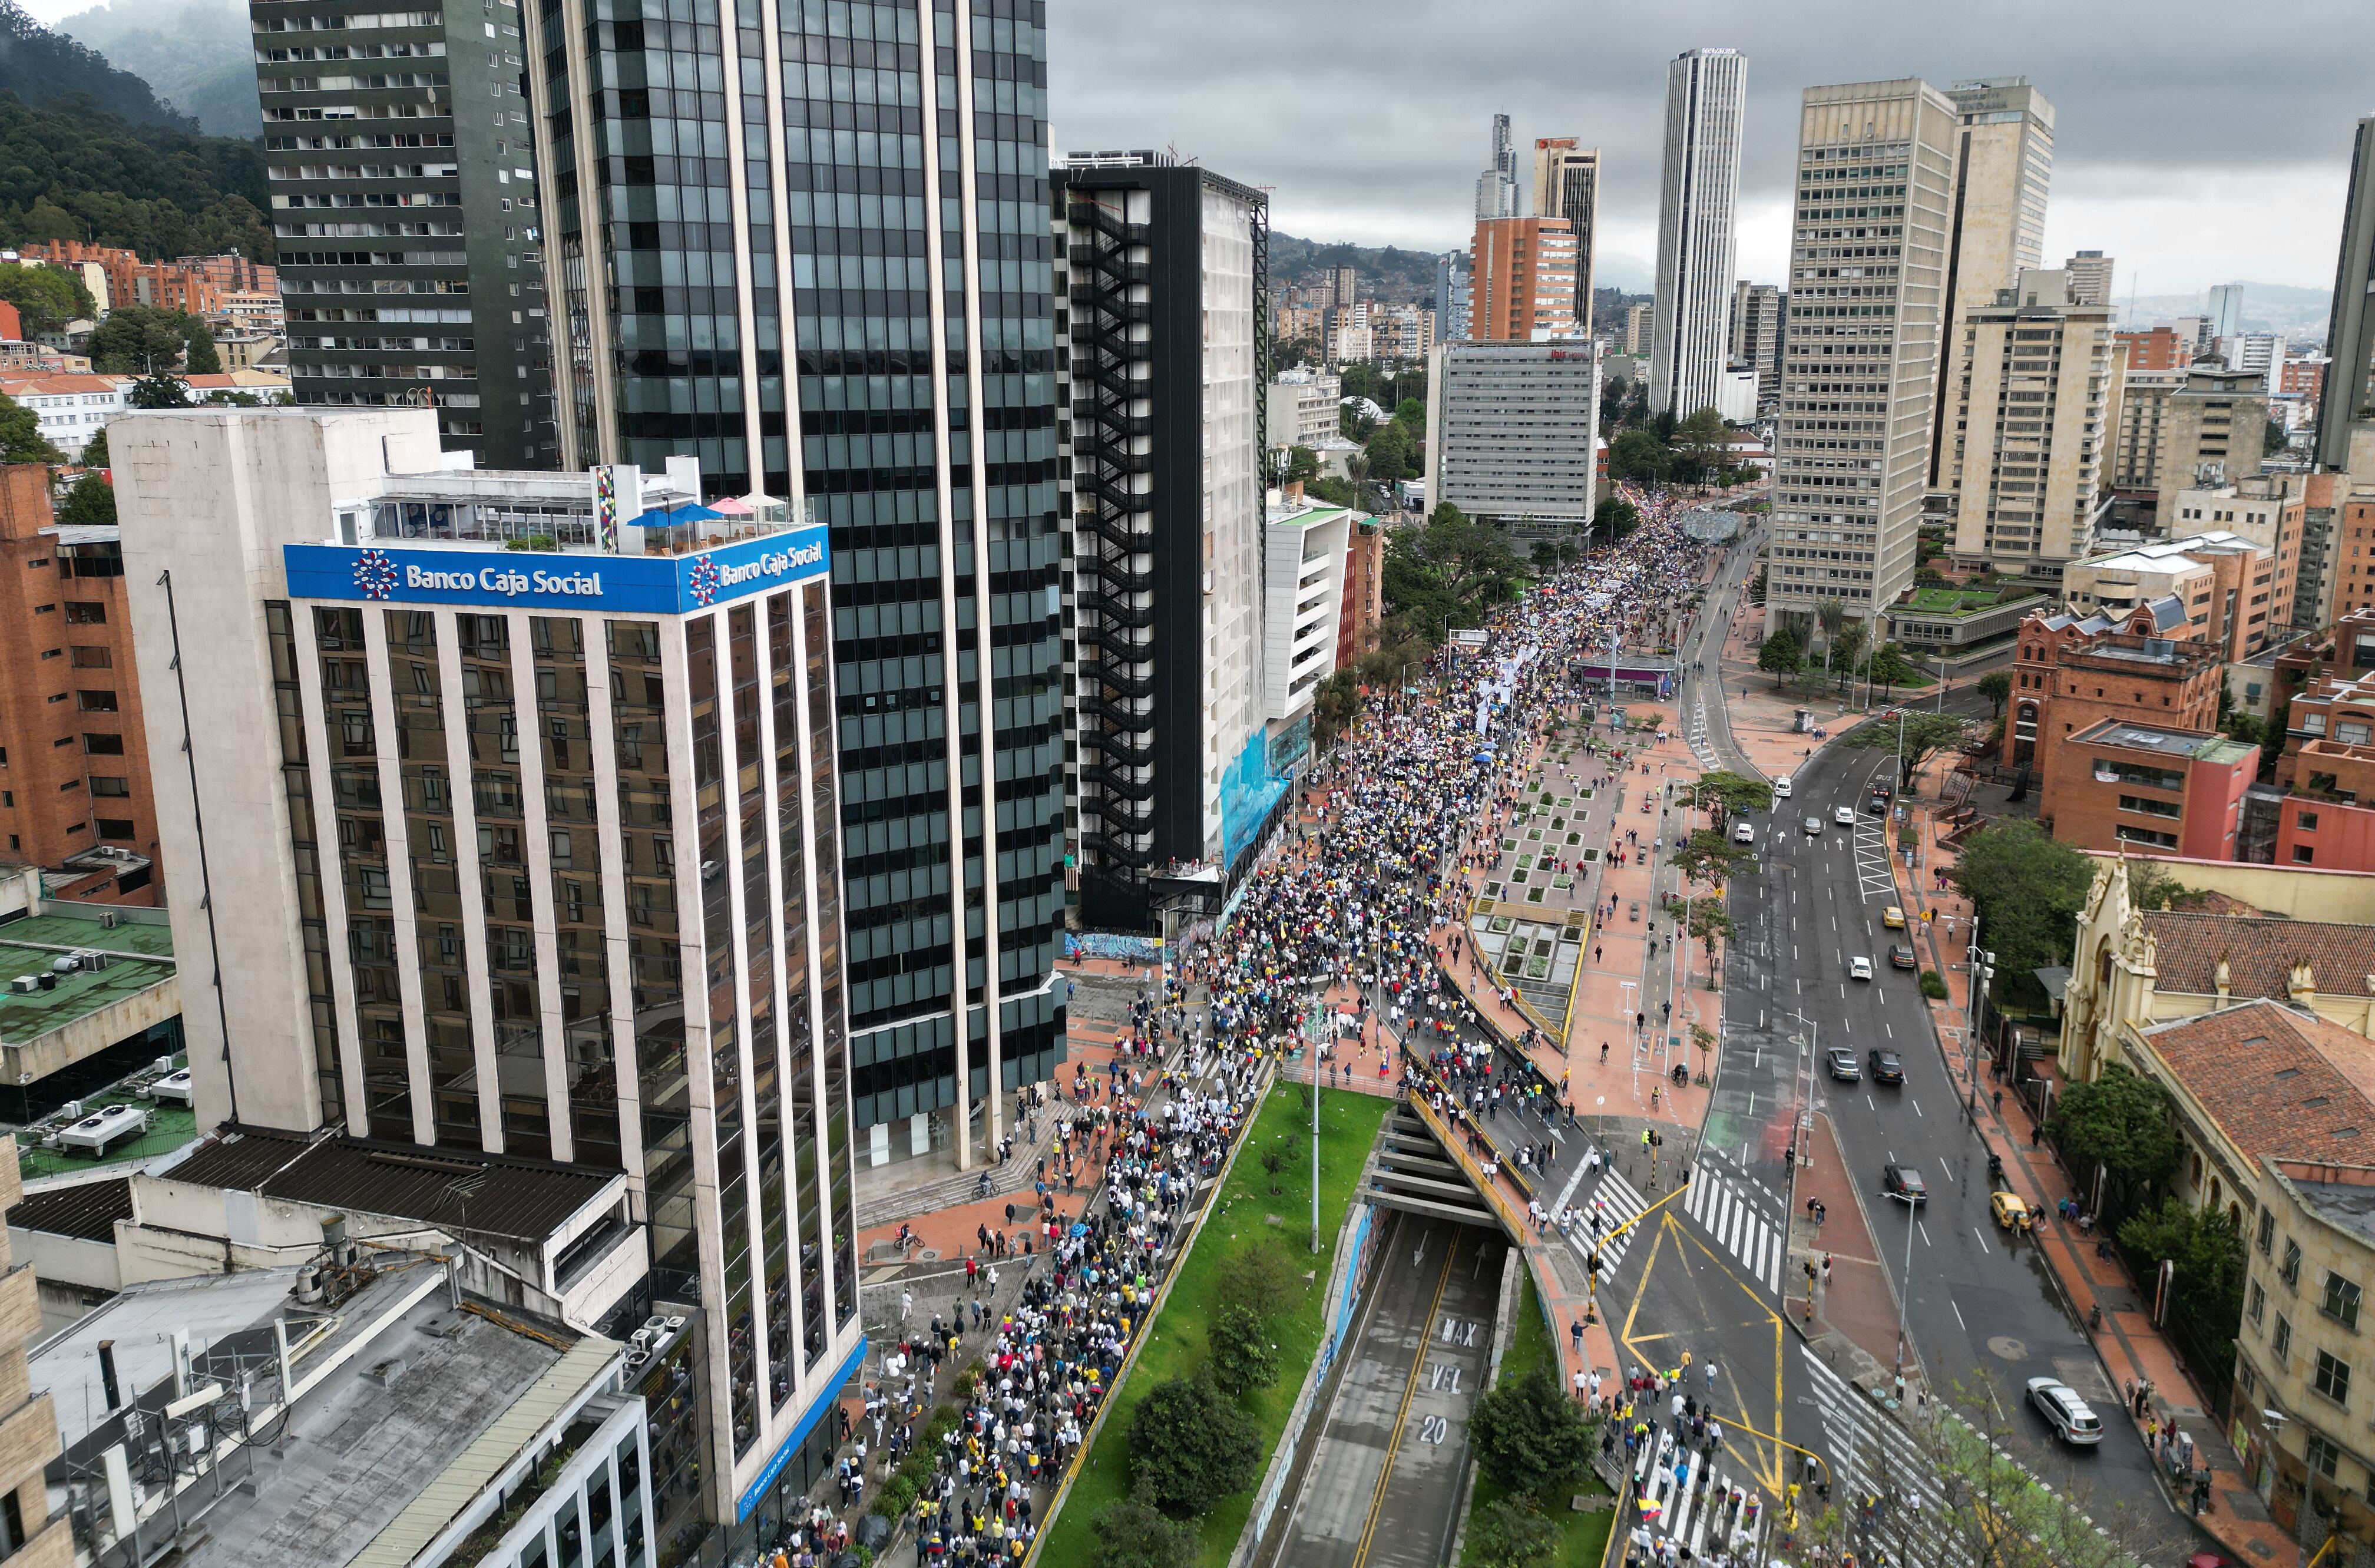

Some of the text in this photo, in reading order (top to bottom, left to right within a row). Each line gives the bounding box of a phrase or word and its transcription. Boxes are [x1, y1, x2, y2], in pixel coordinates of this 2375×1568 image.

[1551, 349, 1567, 359] ibis
[720, 541, 823, 587] Banco Caja Social
[406, 565, 604, 597] Banco Caja Social
[1441, 1318, 1477, 1348] MAX
[1431, 1363, 1461, 1394] VEL
[1420, 1415, 1447, 1445] 20
[754, 1445, 790, 1497] Banco Caja Social
